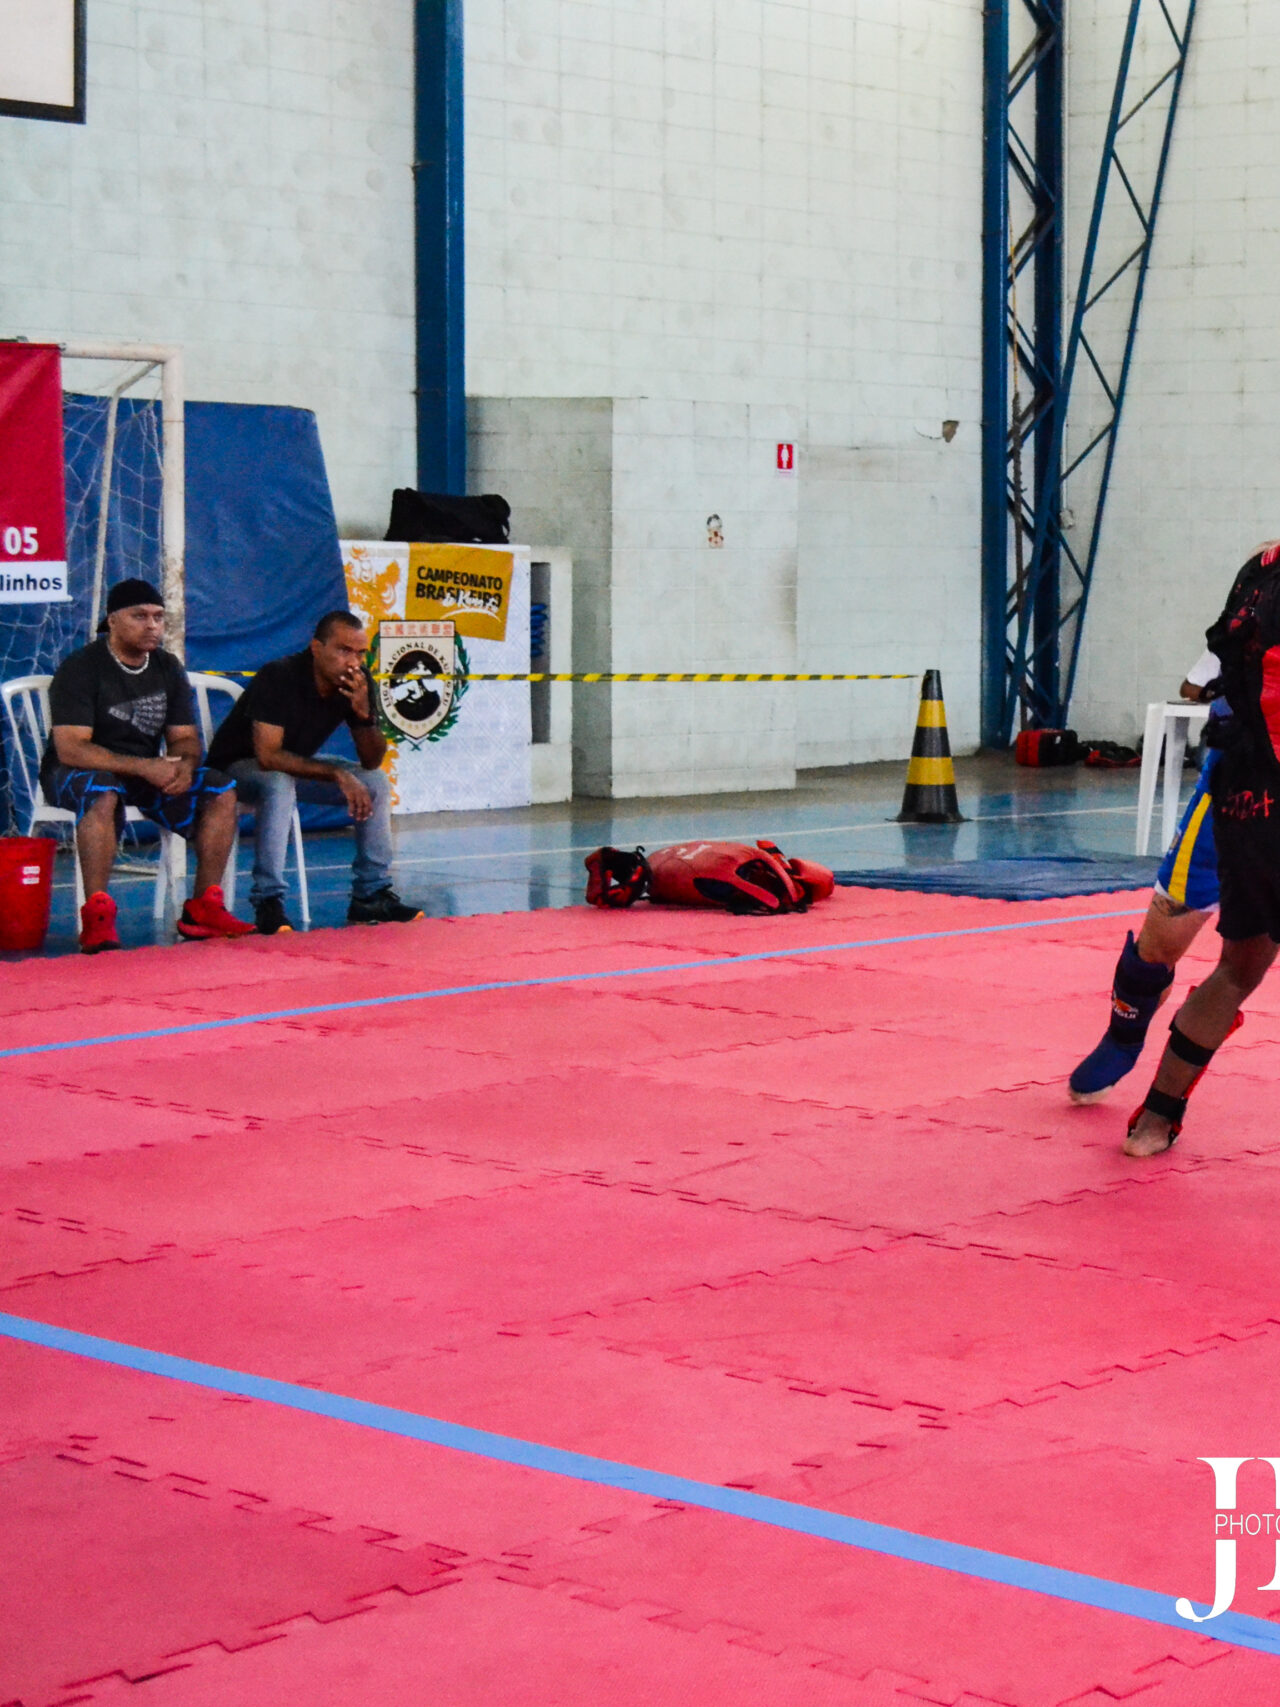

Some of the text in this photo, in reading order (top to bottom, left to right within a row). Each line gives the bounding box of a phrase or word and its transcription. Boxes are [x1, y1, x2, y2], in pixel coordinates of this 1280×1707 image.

[4, 526, 39, 555] 05
[0, 573, 63, 591] linhos
[417, 566, 503, 590] CAMPEONATO
